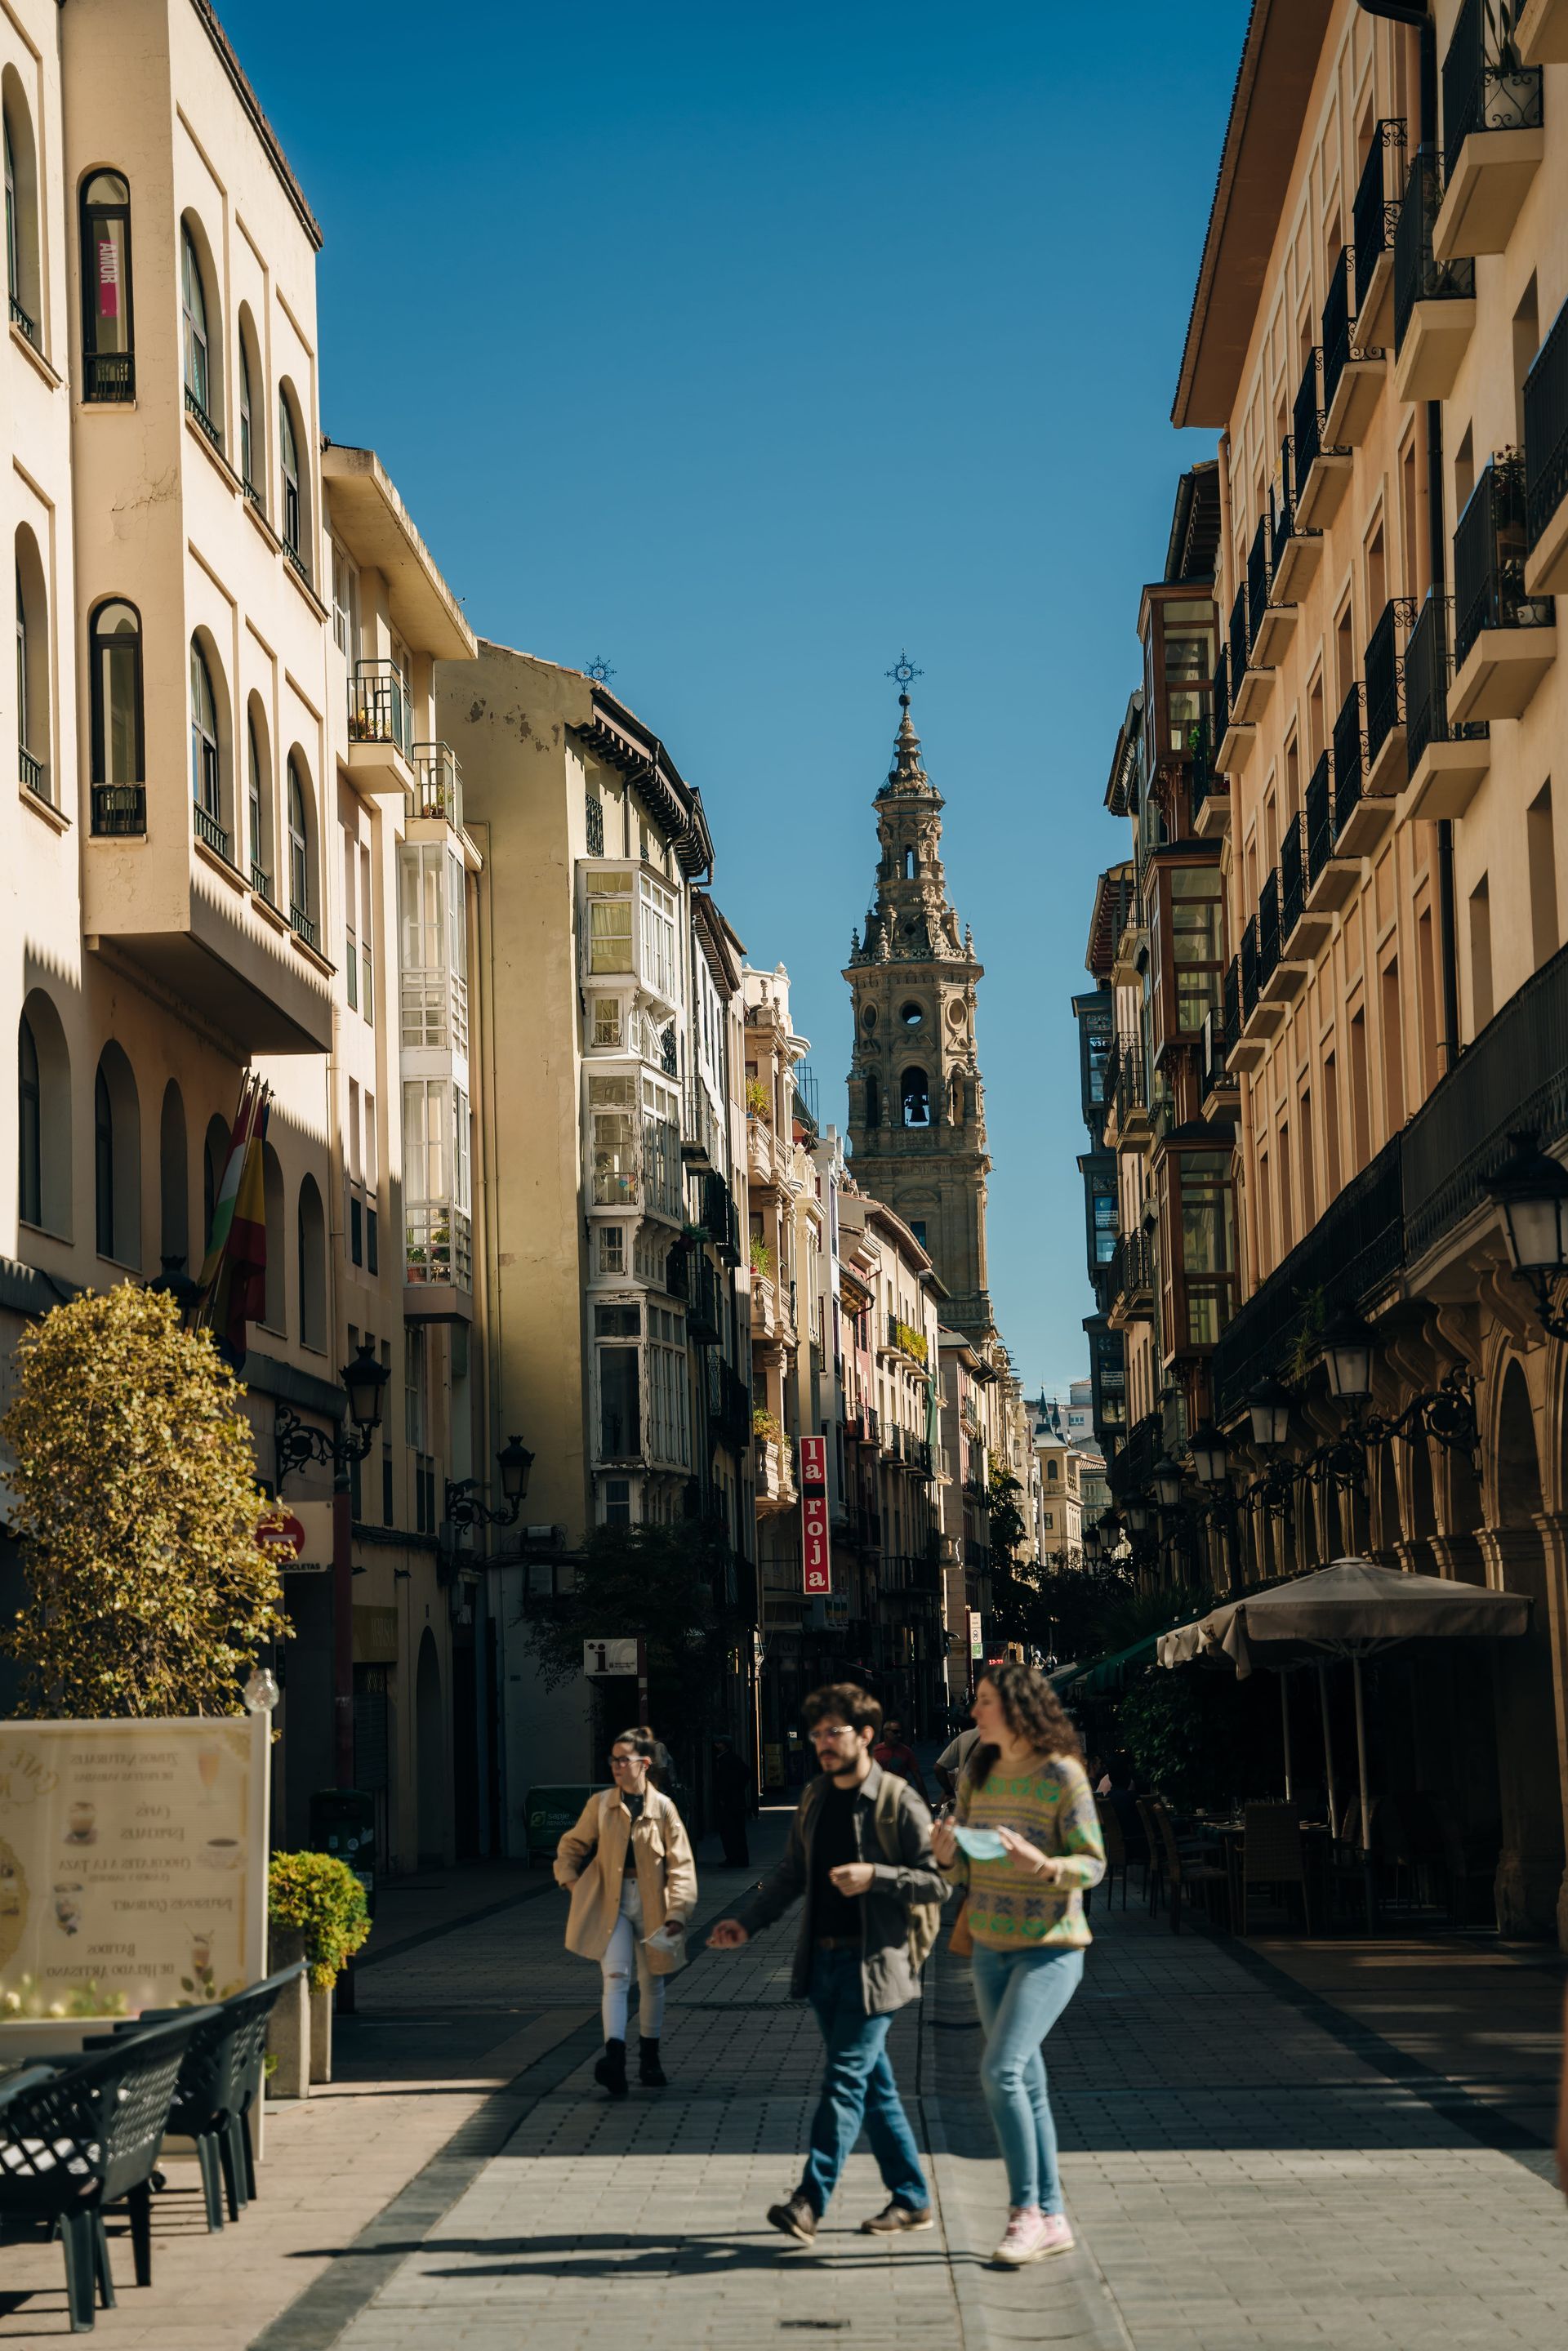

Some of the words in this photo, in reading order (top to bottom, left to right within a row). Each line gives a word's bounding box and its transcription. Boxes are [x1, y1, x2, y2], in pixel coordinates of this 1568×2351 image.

[100, 243, 118, 284] AMOR
[805, 1440, 822, 1480] la
[807, 1499, 826, 1587] roja
